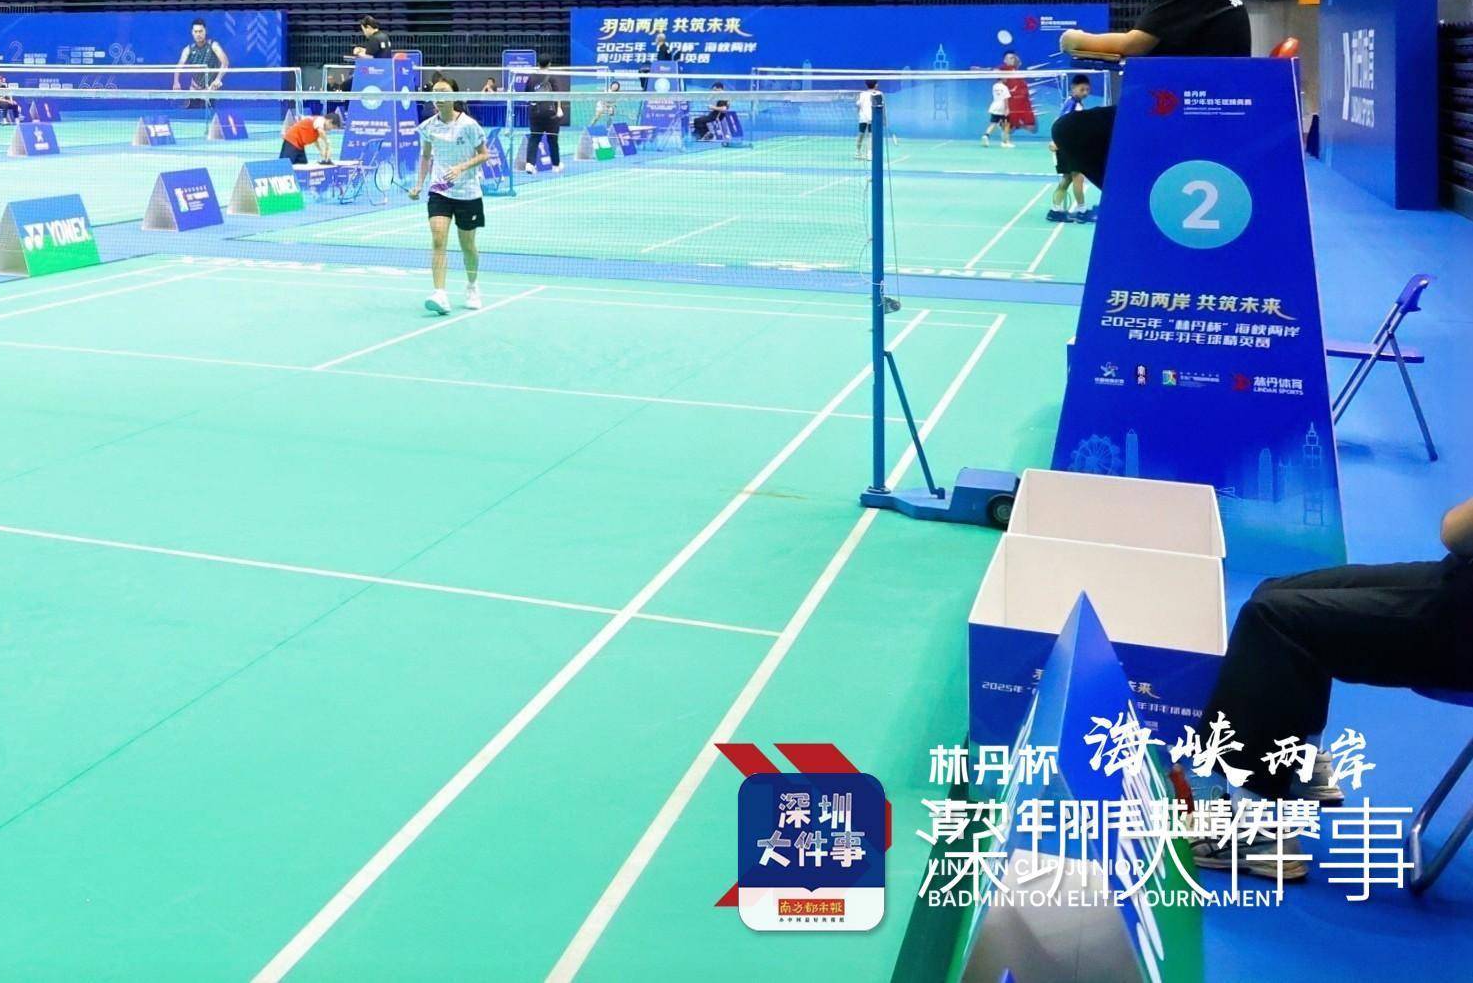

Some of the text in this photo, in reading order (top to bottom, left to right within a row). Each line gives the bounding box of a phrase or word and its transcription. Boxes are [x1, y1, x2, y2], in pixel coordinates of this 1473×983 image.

[598, 18, 753, 40] 羽动两岸 共筑未来
[1181, 180, 1221, 230] 2
[47, 217, 90, 246] YONEX
[1106, 290, 1297, 321] 羽动两岸 共筑未来
[1101, 316, 1162, 329] 2025年
[1235, 323, 1301, 338] 海峡两岸
[1128, 329, 1271, 349] 青少年羽毛球精英赛
[982, 681, 1023, 694] 2025年
